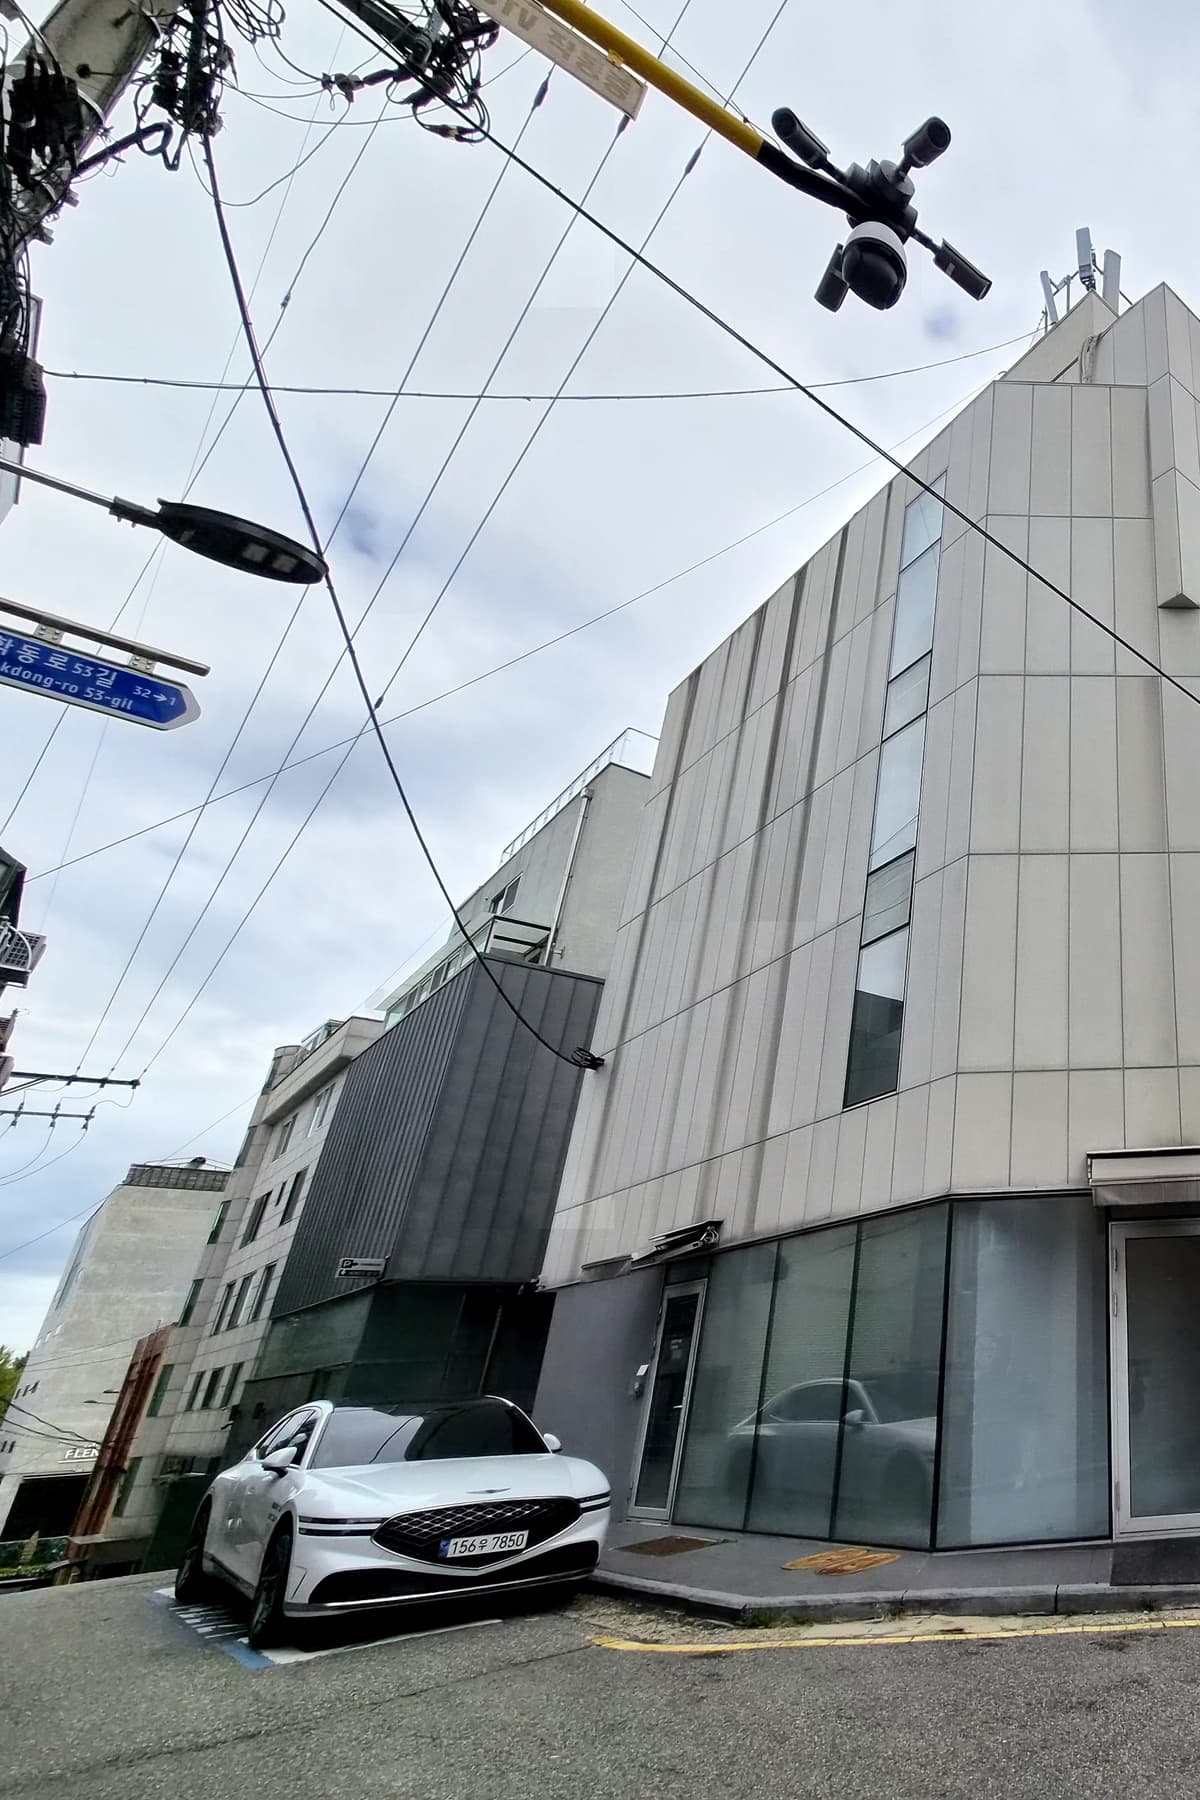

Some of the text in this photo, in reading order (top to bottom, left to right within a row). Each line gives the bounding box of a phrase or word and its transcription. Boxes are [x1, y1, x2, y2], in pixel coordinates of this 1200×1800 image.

[83, 687, 133, 710] 53-gil
[132, 685, 152, 699] 32
[452, 1533, 525, 1555] 156우 7850
